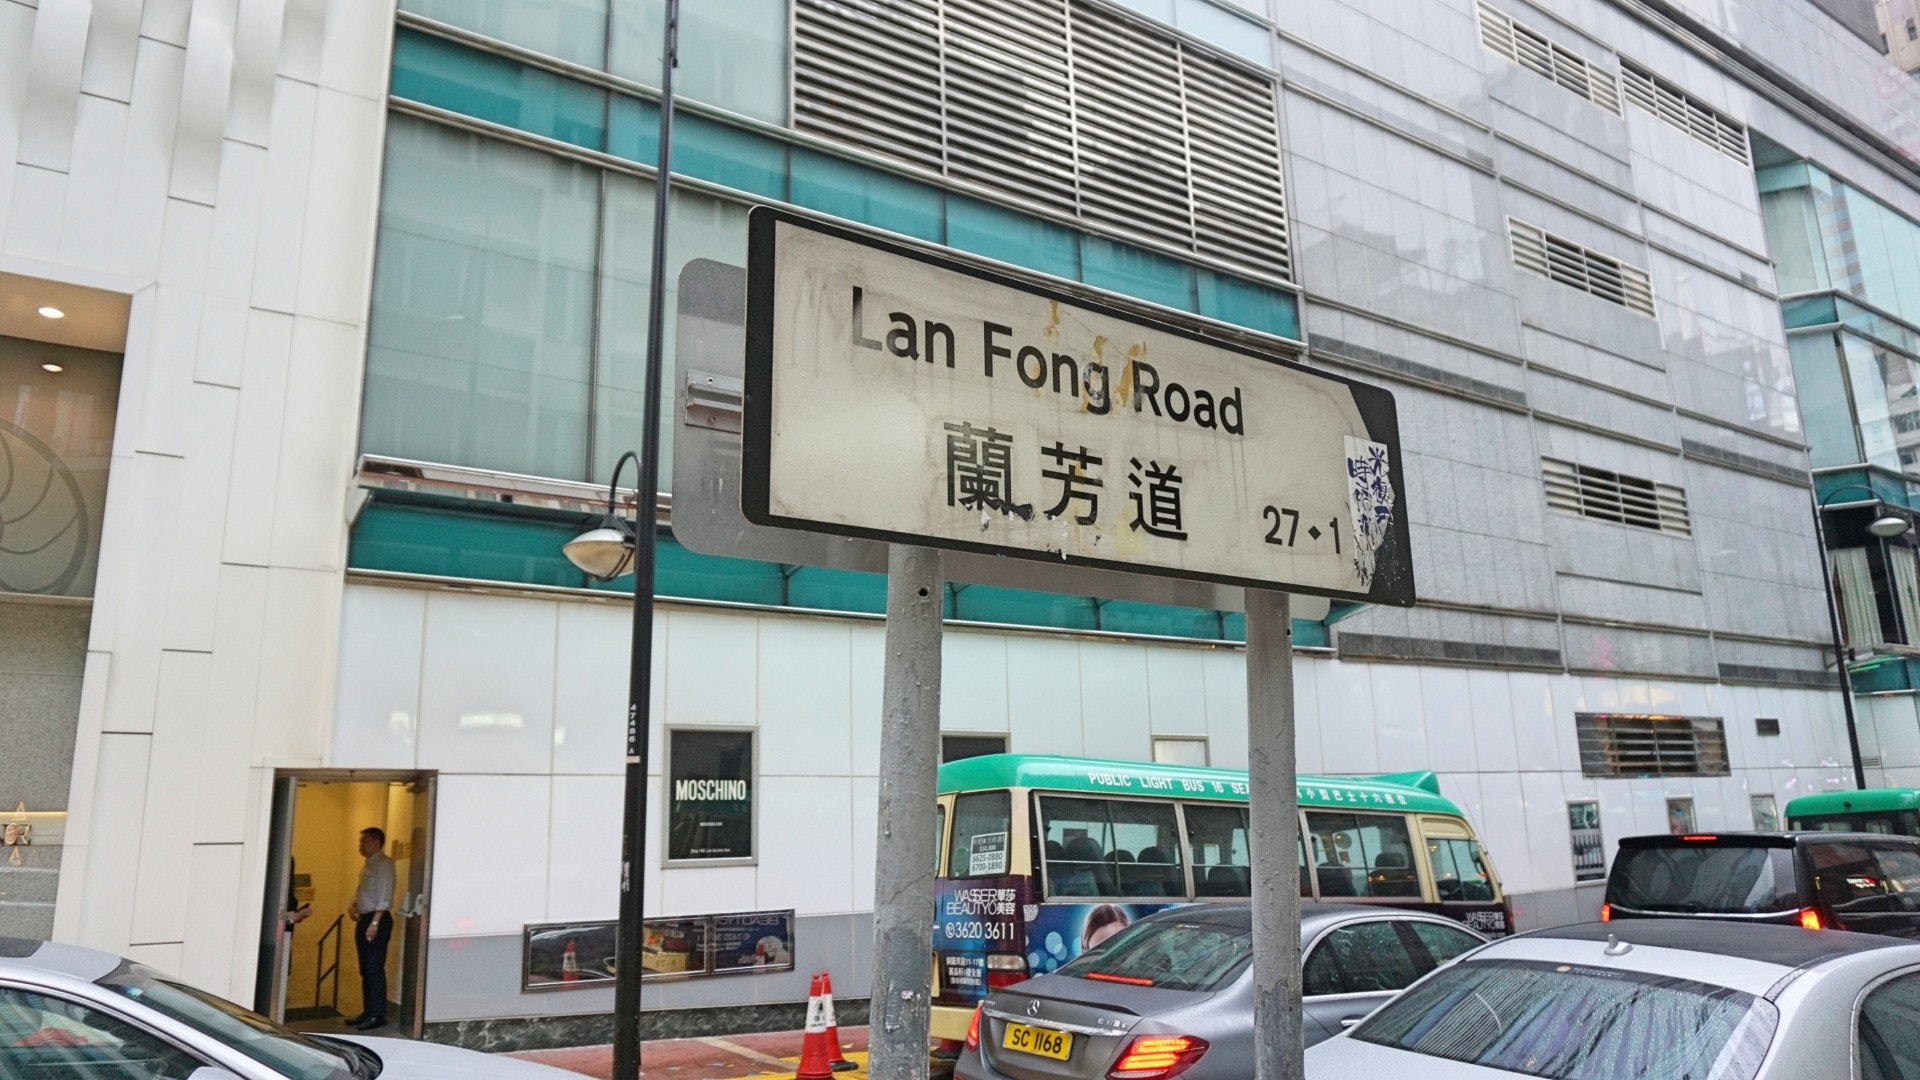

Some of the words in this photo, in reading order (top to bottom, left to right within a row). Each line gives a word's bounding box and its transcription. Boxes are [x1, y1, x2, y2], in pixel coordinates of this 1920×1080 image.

[852, 285, 955, 368] Lan
[983, 320, 1111, 416] Fong
[1131, 359, 1245, 436] Road
[943, 421, 1188, 541] 蘭芳道
[1262, 504, 1300, 547] 27
[629, 703, 638, 743] 47486
[675, 779, 747, 801] MOSCHINO
[1088, 772, 1132, 787] PUBLIC
[1138, 775, 1174, 790] LIGHT
[1181, 779, 1205, 792] BUS
[1211, 781, 1224, 793] 16
[972, 861, 1003, 872] 6700-1890
[954, 888, 997, 902] WASSER
[996, 901, 1015, 915] 美容
[955, 921, 982, 939] 3620
[984, 921, 1014, 940] 3611
[1011, 1028, 1030, 1047] SC
[1034, 1032, 1063, 1054] 1168
